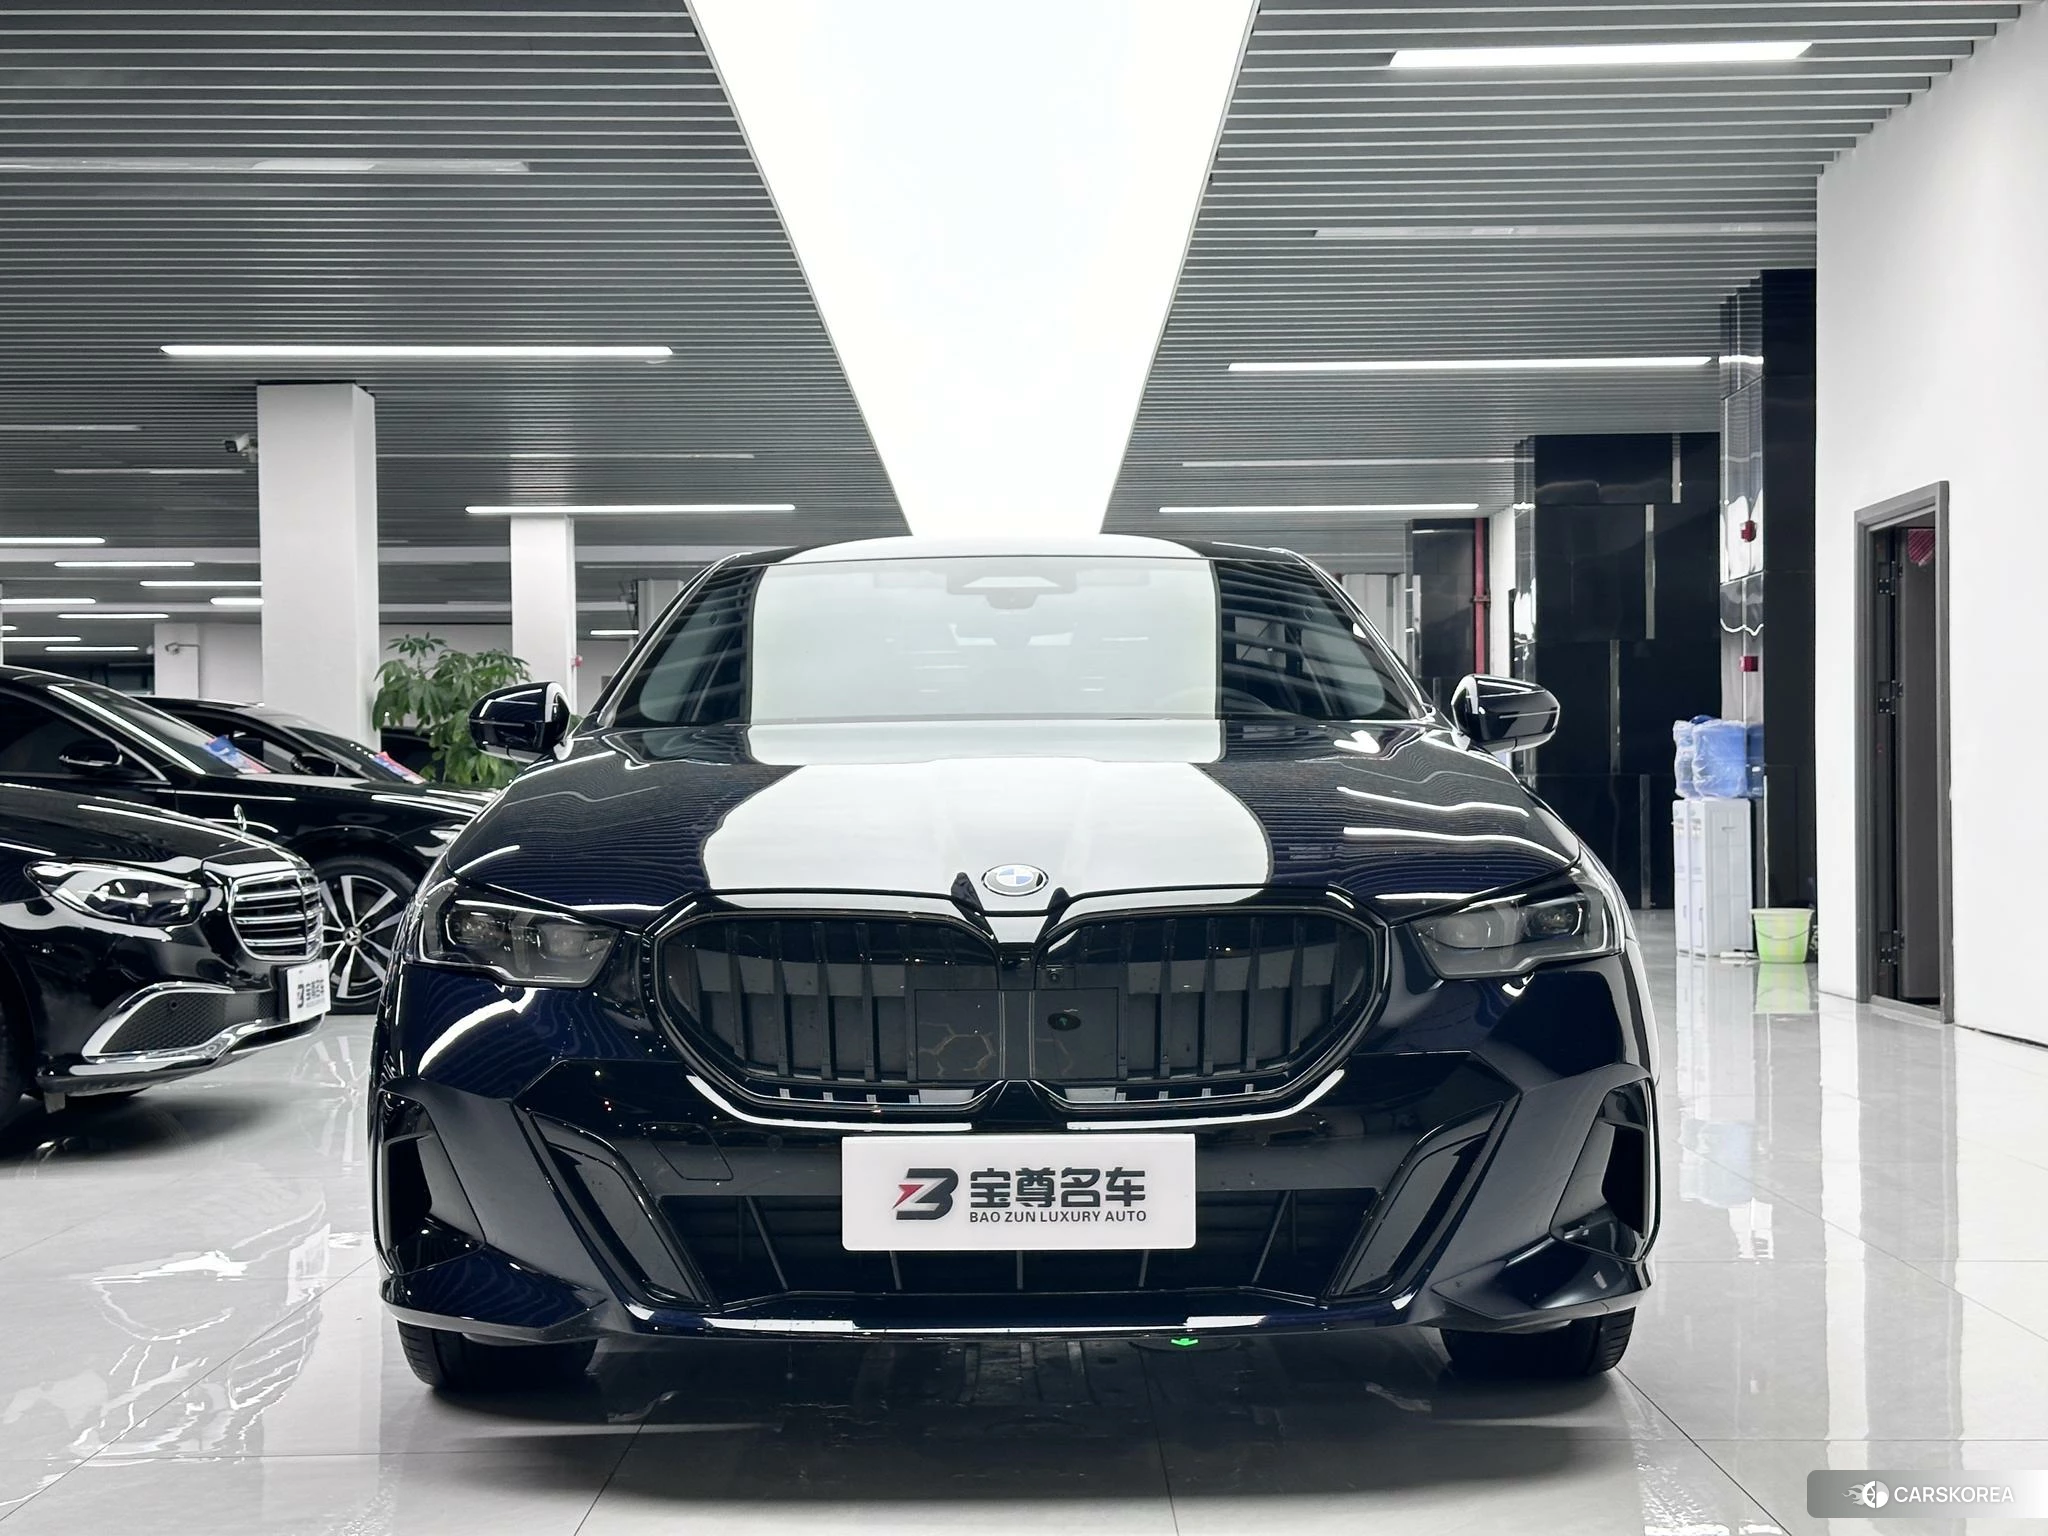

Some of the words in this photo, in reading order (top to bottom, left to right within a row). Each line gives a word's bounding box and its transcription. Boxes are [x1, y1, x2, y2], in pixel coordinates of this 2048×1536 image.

[970, 1167, 1146, 1207] 宝尊名车
[969, 1211, 1001, 1223] BAO
[1004, 1211, 1036, 1223] ZUN
[1040, 1211, 1101, 1223] LUXURY
[1105, 1211, 1147, 1222] AUTO
